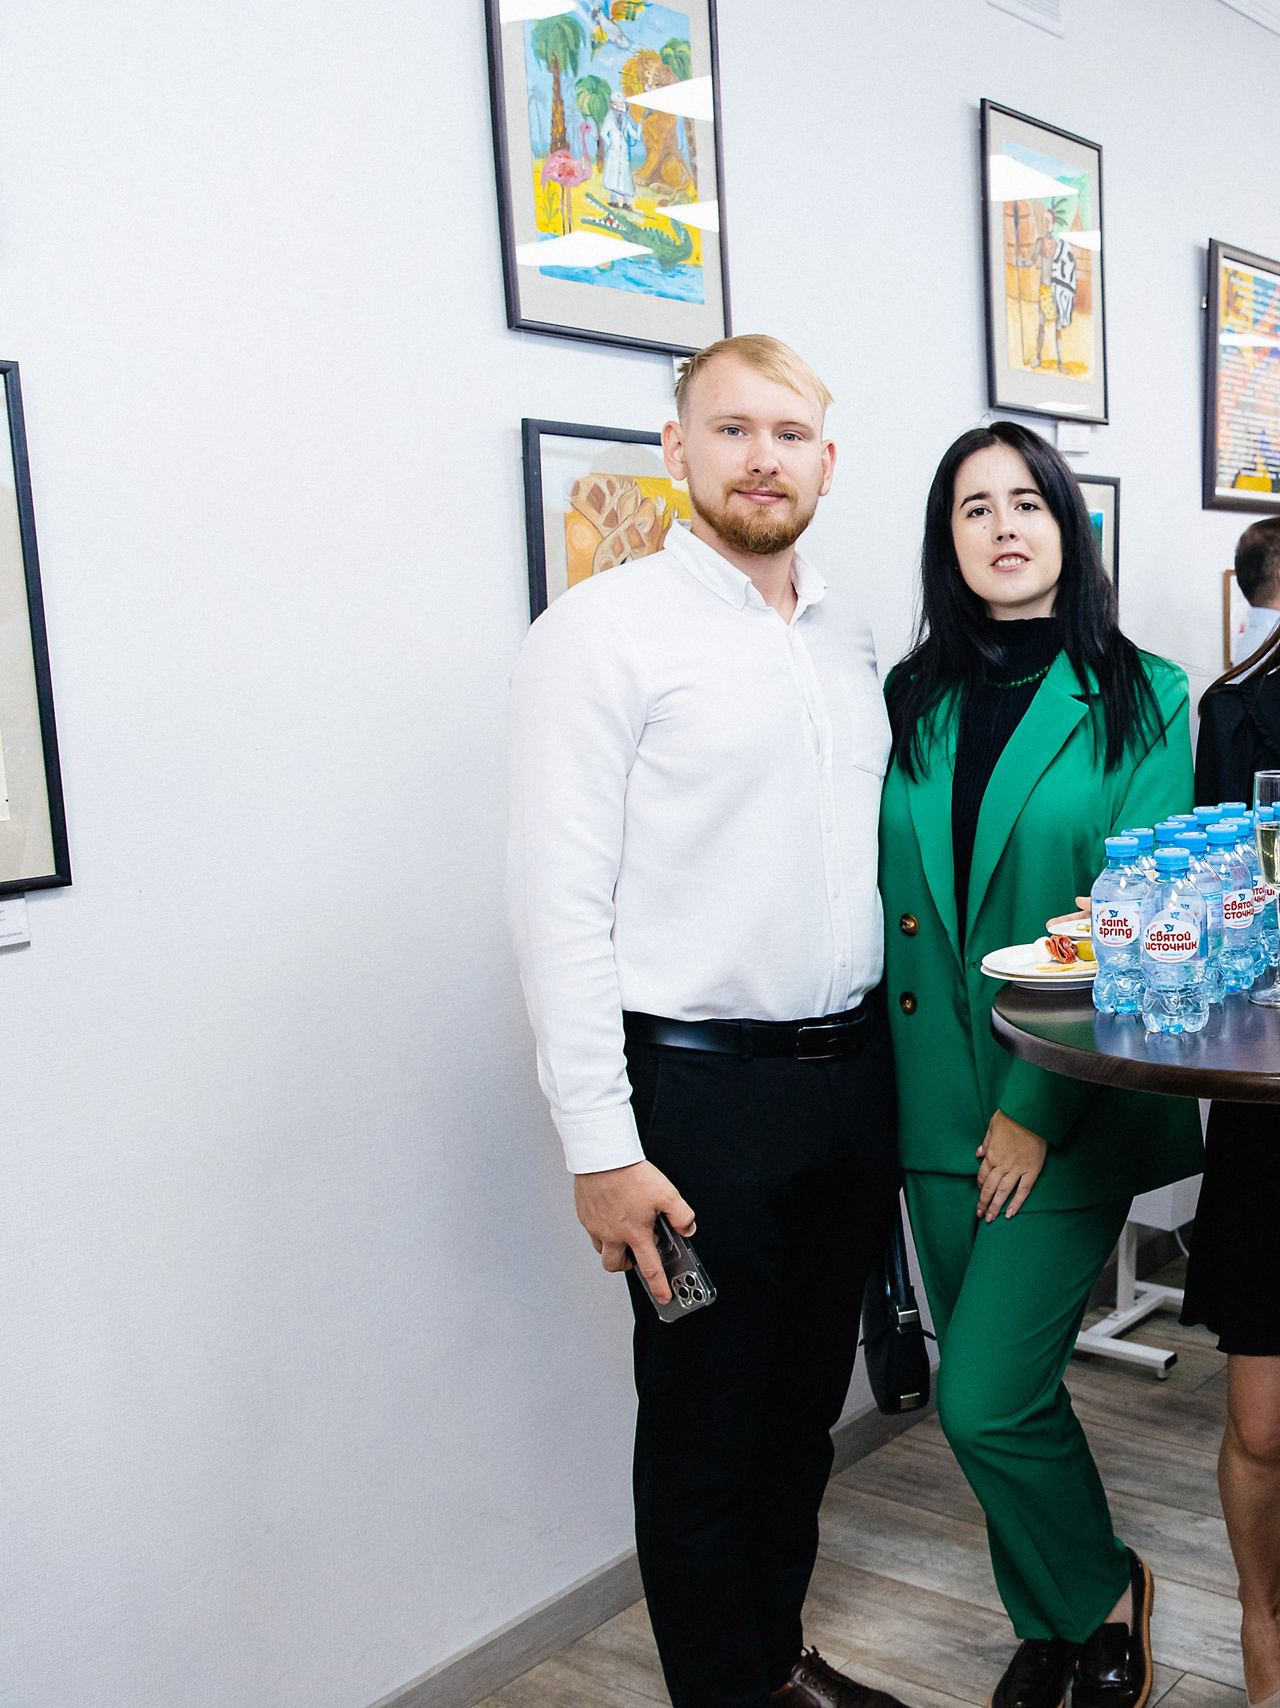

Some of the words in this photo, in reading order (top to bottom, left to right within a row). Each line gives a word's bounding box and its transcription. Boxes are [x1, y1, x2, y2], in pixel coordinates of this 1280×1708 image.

[1101, 917, 1129, 928] saint
[1098, 926, 1133, 939] spring
[1149, 930, 1191, 942] святой
[1145, 940, 1198, 952] источник
